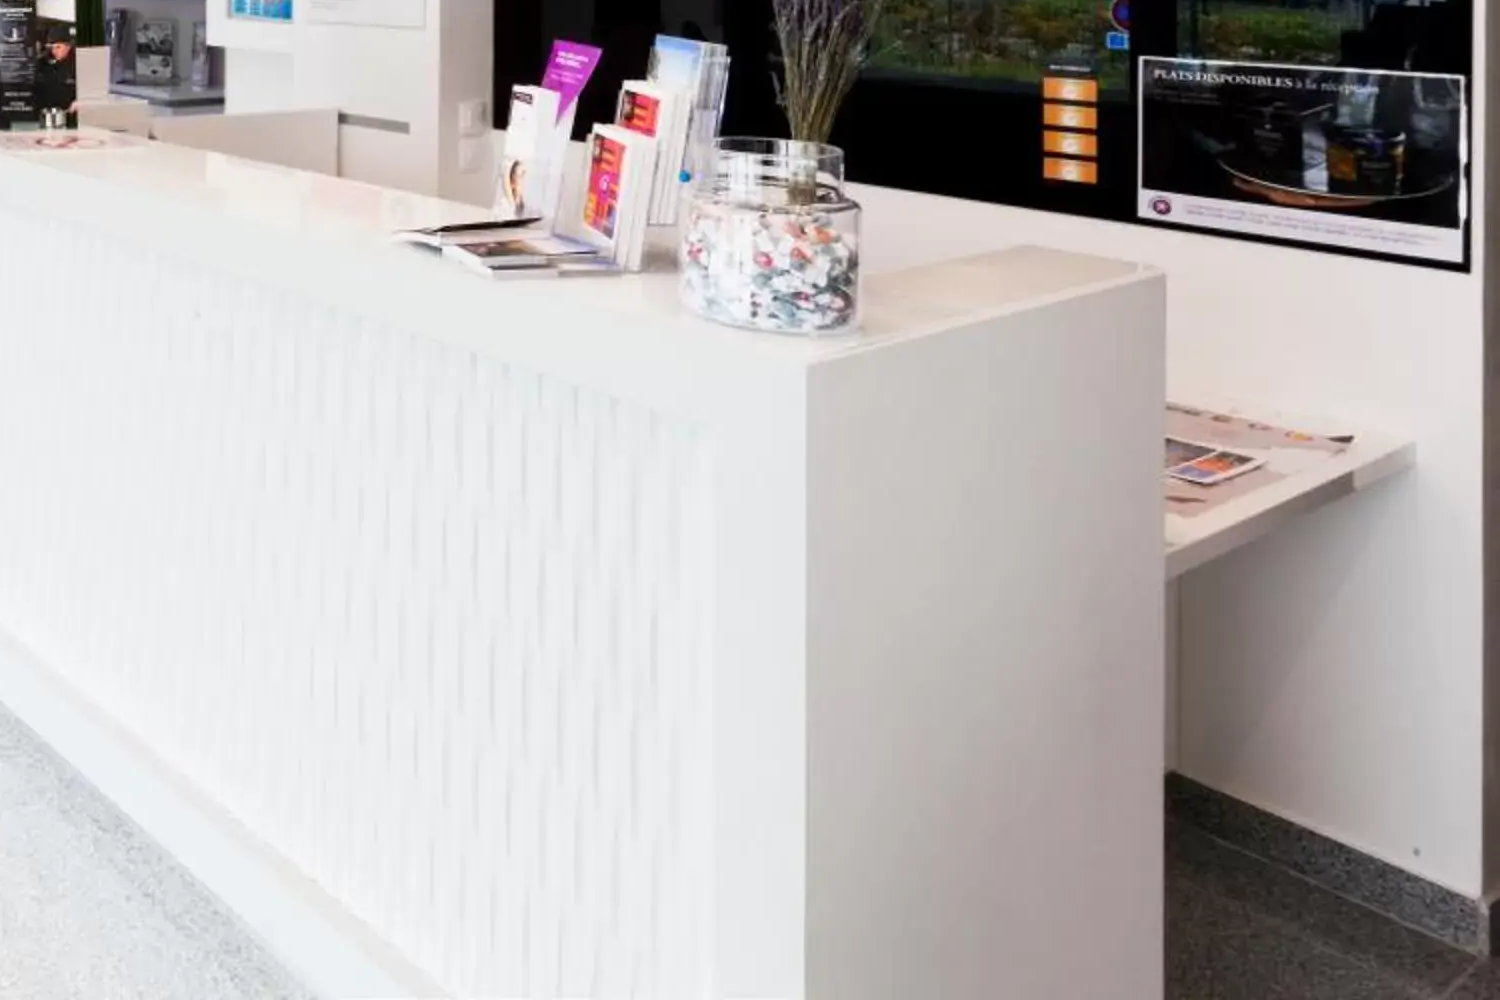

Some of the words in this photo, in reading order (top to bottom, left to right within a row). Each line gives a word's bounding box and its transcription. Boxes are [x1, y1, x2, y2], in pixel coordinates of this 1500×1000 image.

[1153, 69, 1193, 82] PLATS
[1194, 71, 1293, 89] DISPONIBLES
[1304, 78, 1317, 90] la
